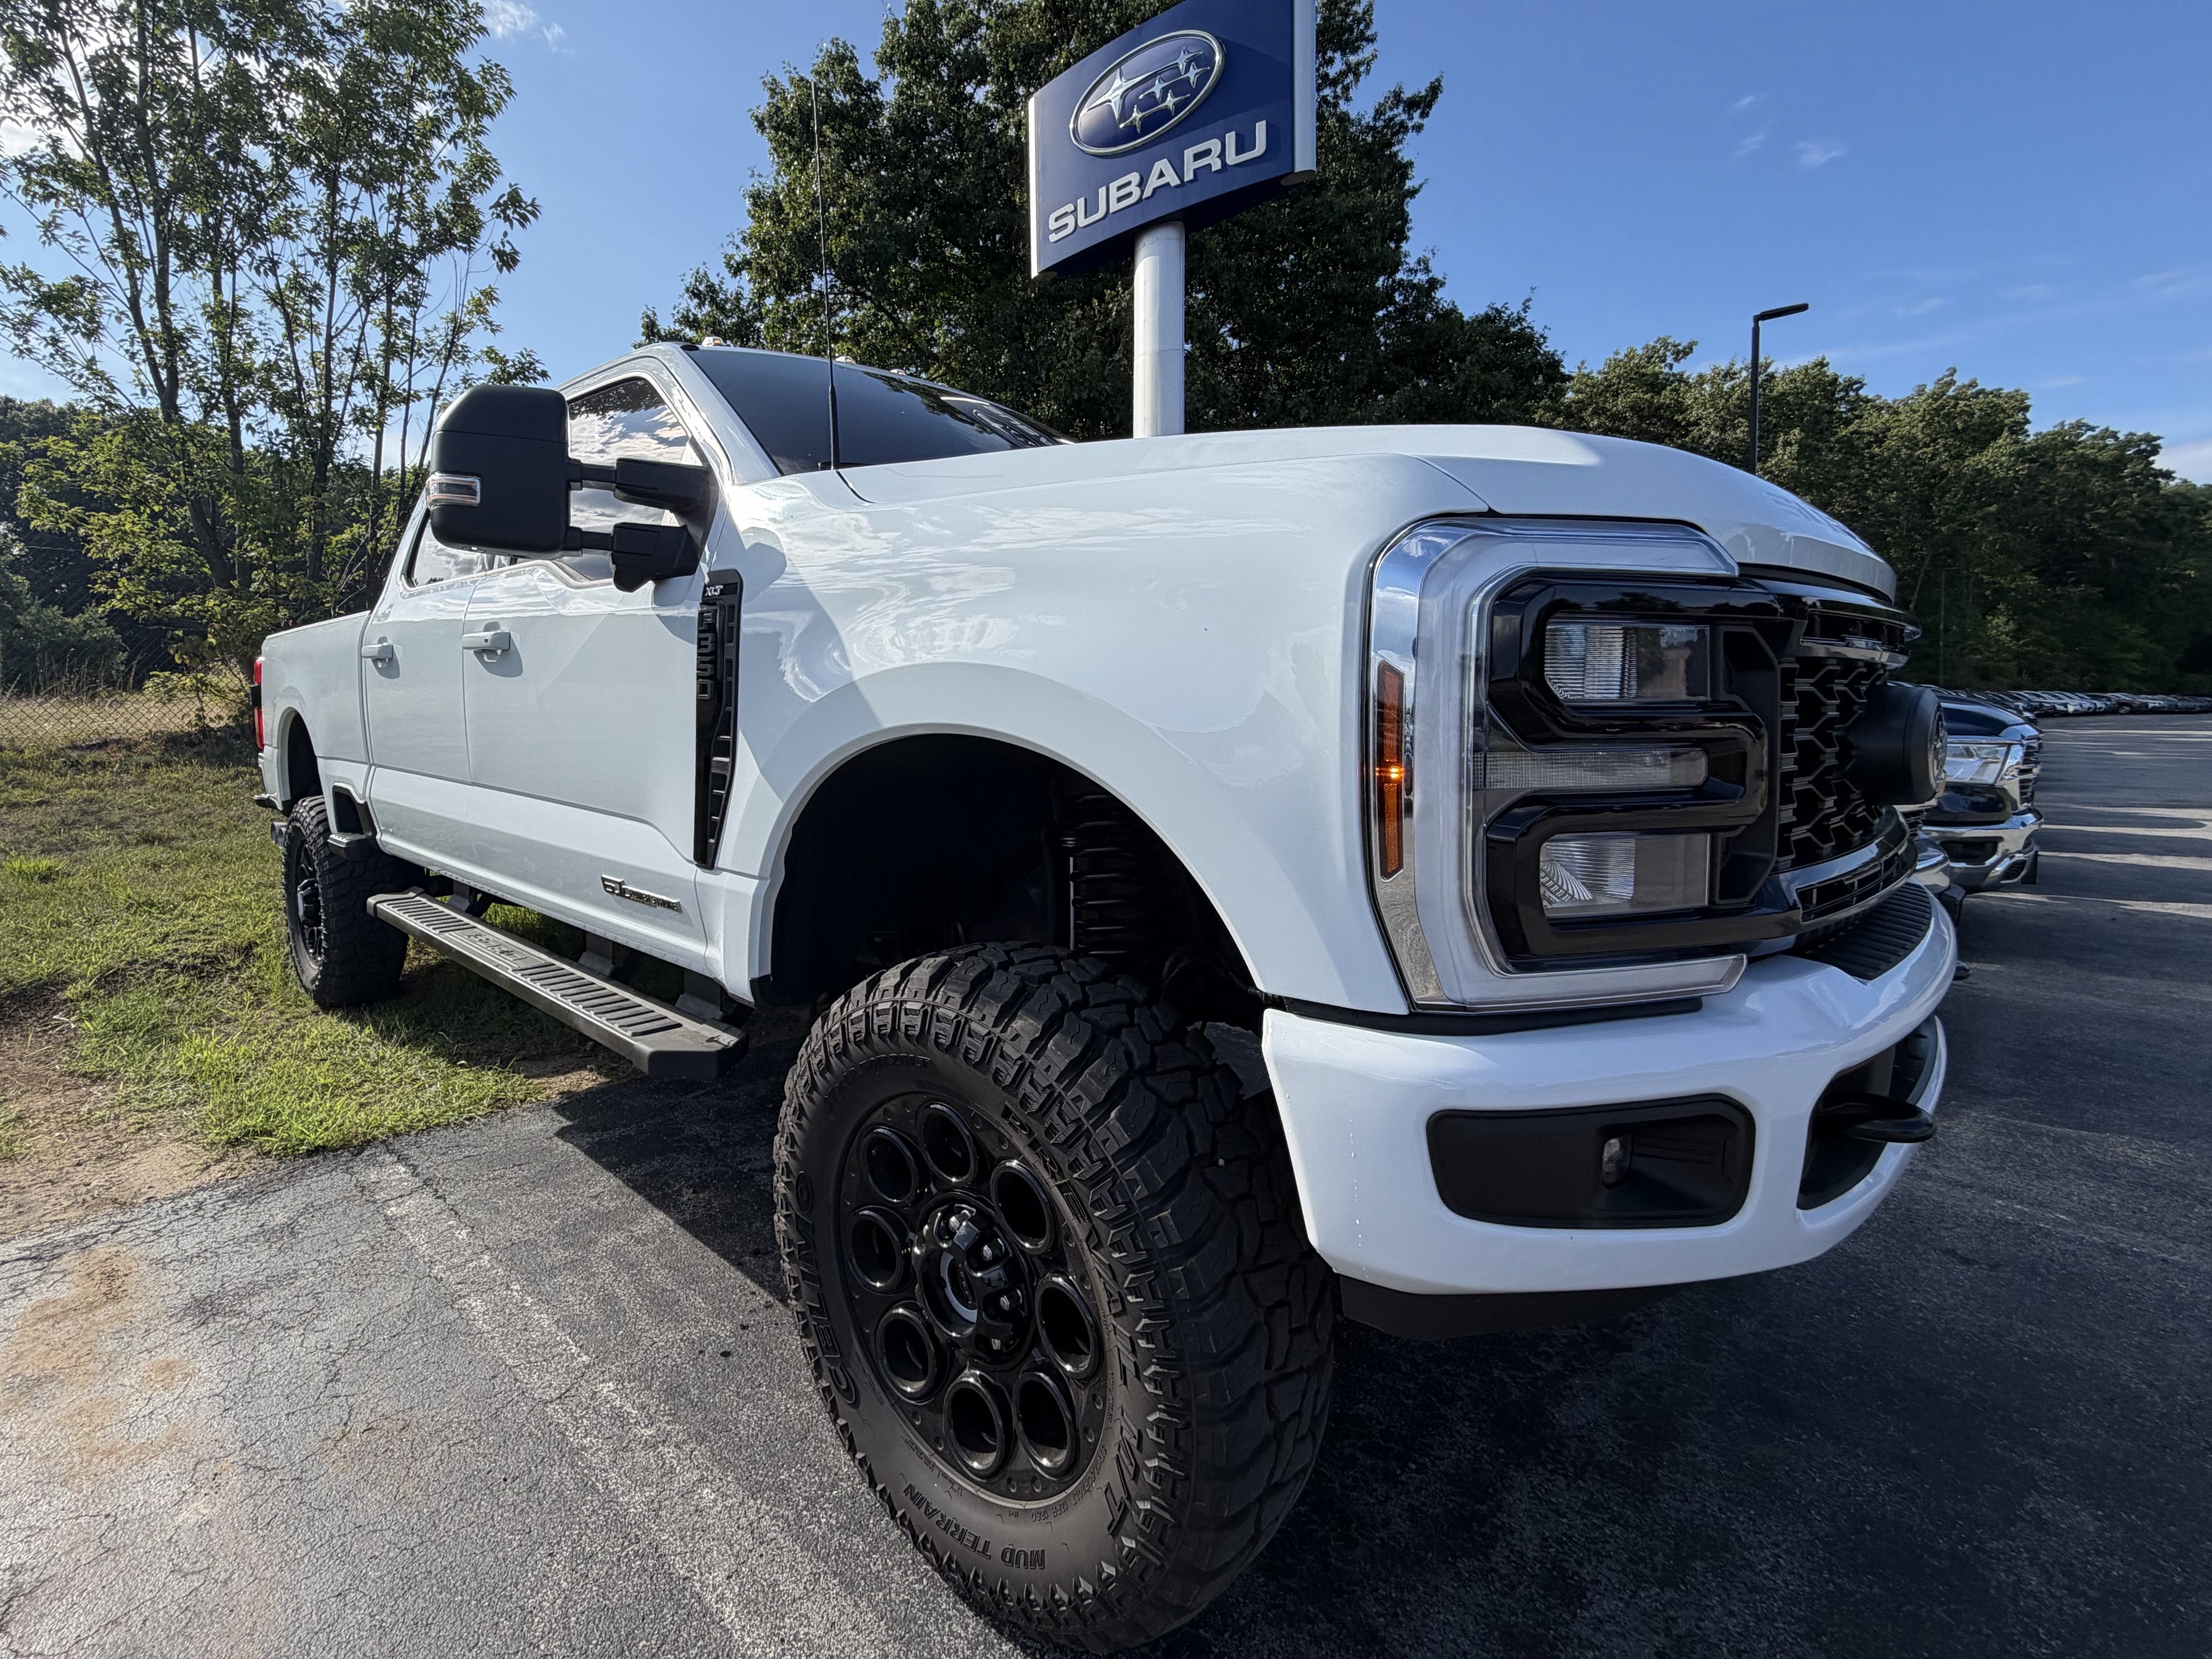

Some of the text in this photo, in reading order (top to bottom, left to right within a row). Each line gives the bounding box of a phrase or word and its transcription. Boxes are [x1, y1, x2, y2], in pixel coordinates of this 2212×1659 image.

[1049, 120, 1267, 243] SUBARU
[705, 585, 724, 596] XLT
[903, 1483, 991, 1559] TERRAIN
[1001, 1547, 1045, 1570] MUD
